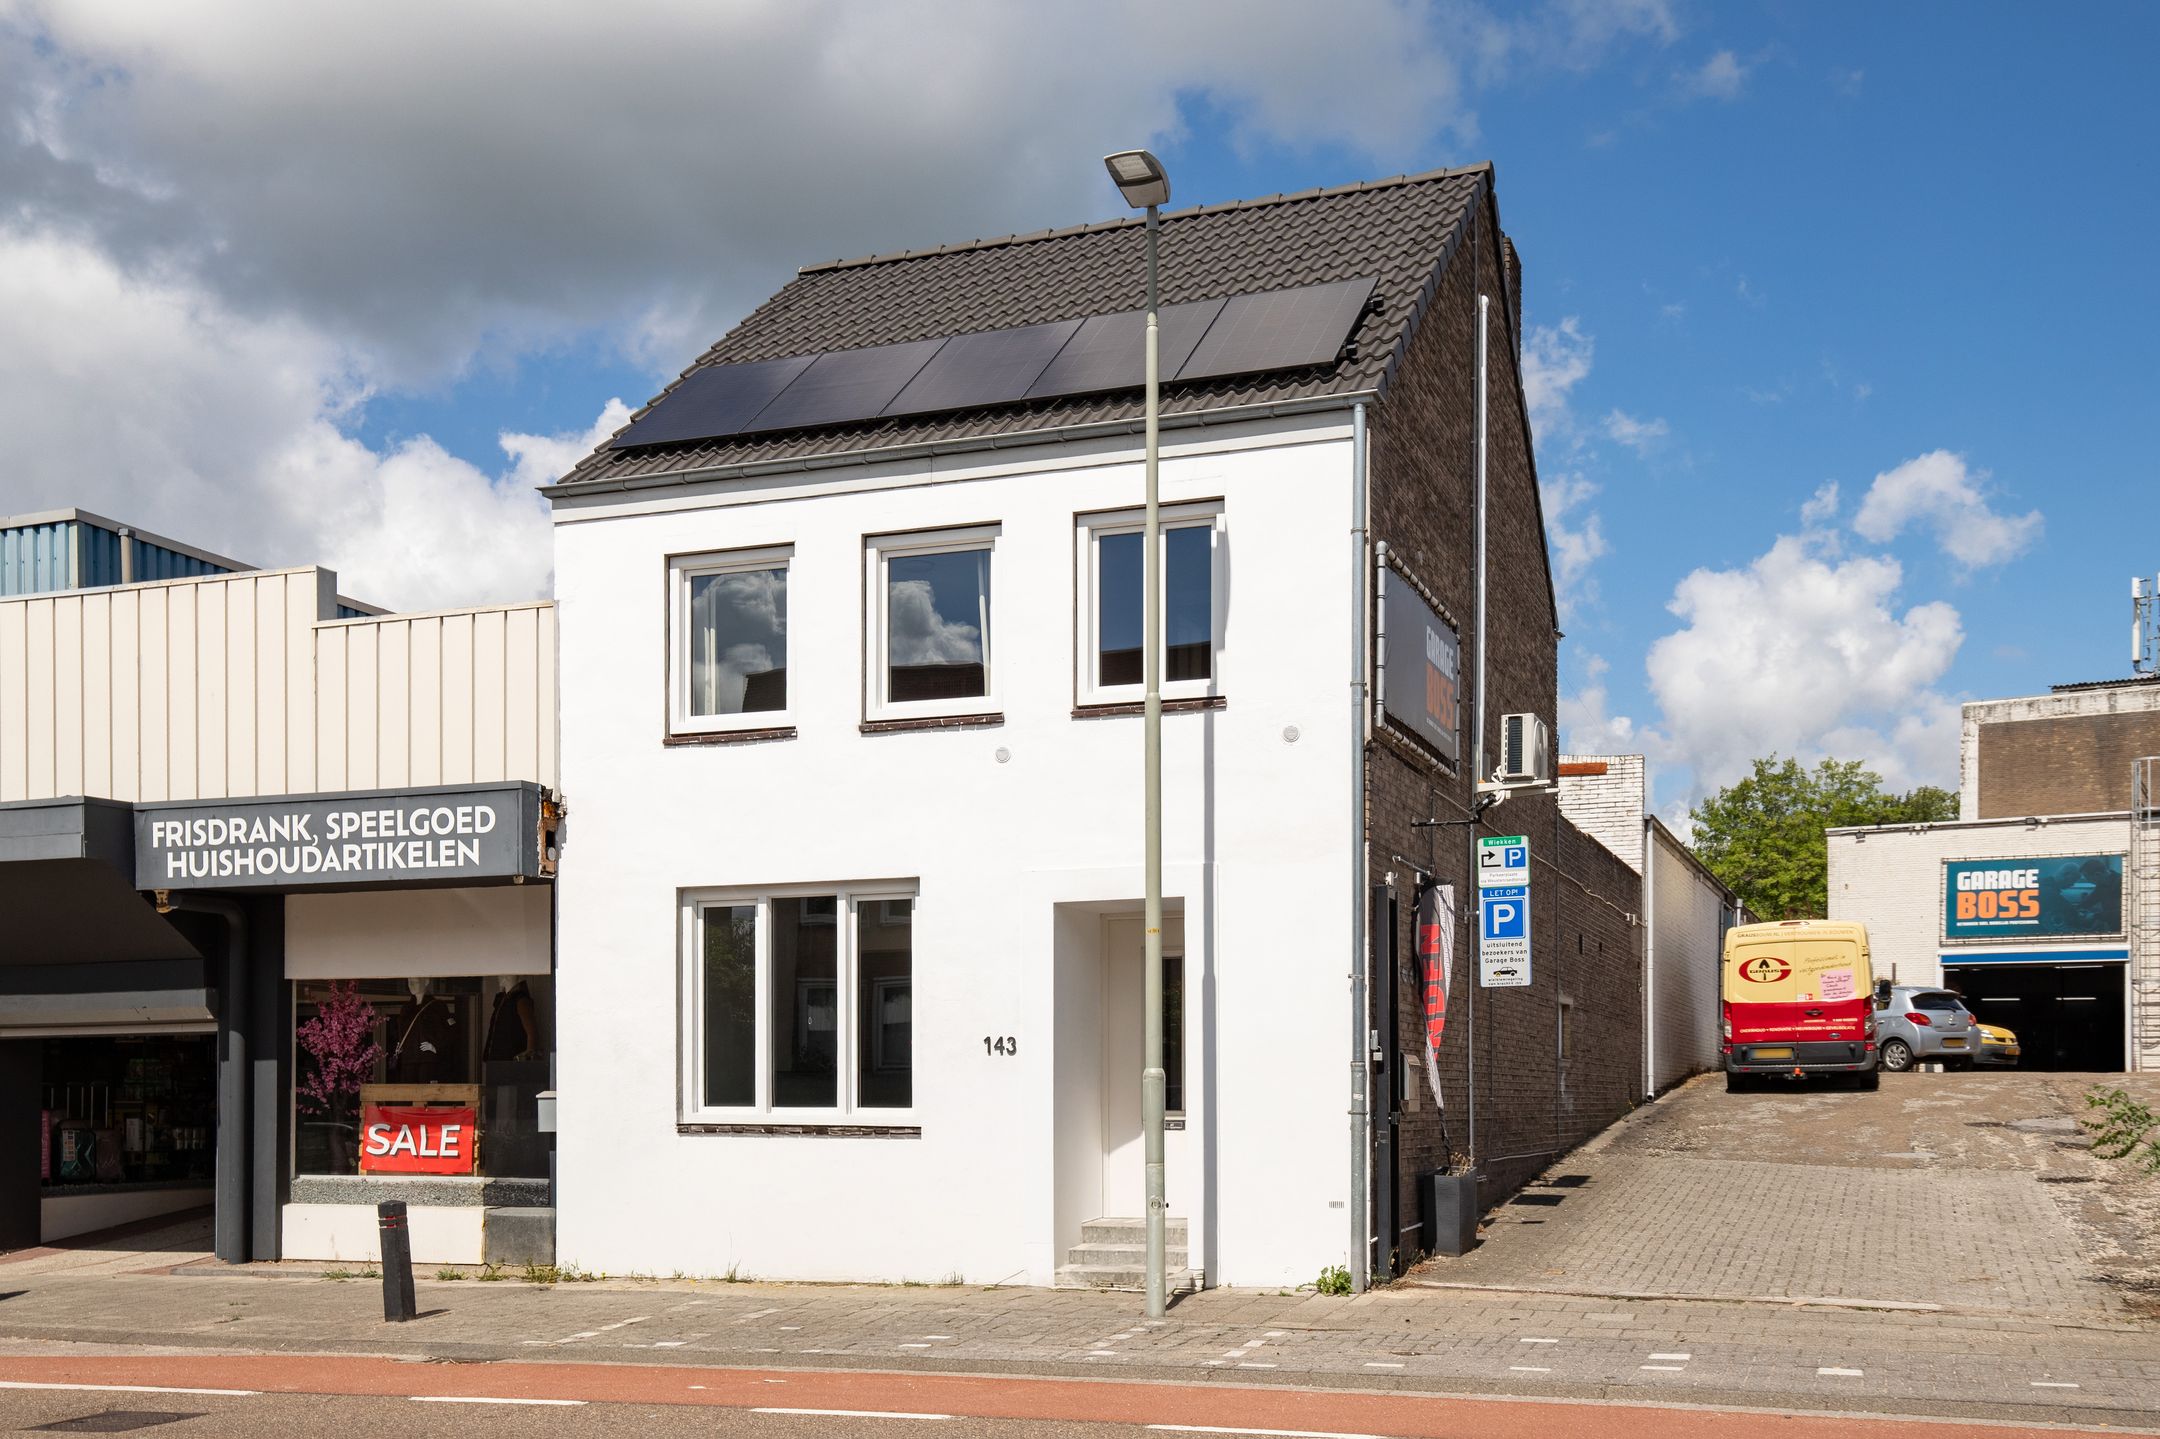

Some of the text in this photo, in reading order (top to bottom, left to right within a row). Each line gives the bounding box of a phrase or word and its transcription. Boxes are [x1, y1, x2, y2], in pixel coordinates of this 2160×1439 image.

[1426, 624, 1454, 681] GARAGE
[1426, 662, 1457, 732] BOSS
[152, 805, 496, 849] FRISDRANK, SPEELGOED
[167, 838, 480, 878] HUISHOUDARTIKELEN
[1508, 849, 1522, 867] P
[1489, 888, 1518, 897] LET OP!
[1956, 868, 2040, 891] GARAGE
[1493, 903, 1516, 935] P
[1956, 889, 2040, 920] BOSS
[983, 1036, 1017, 1057] 143
[365, 1123, 461, 1158] SALE
